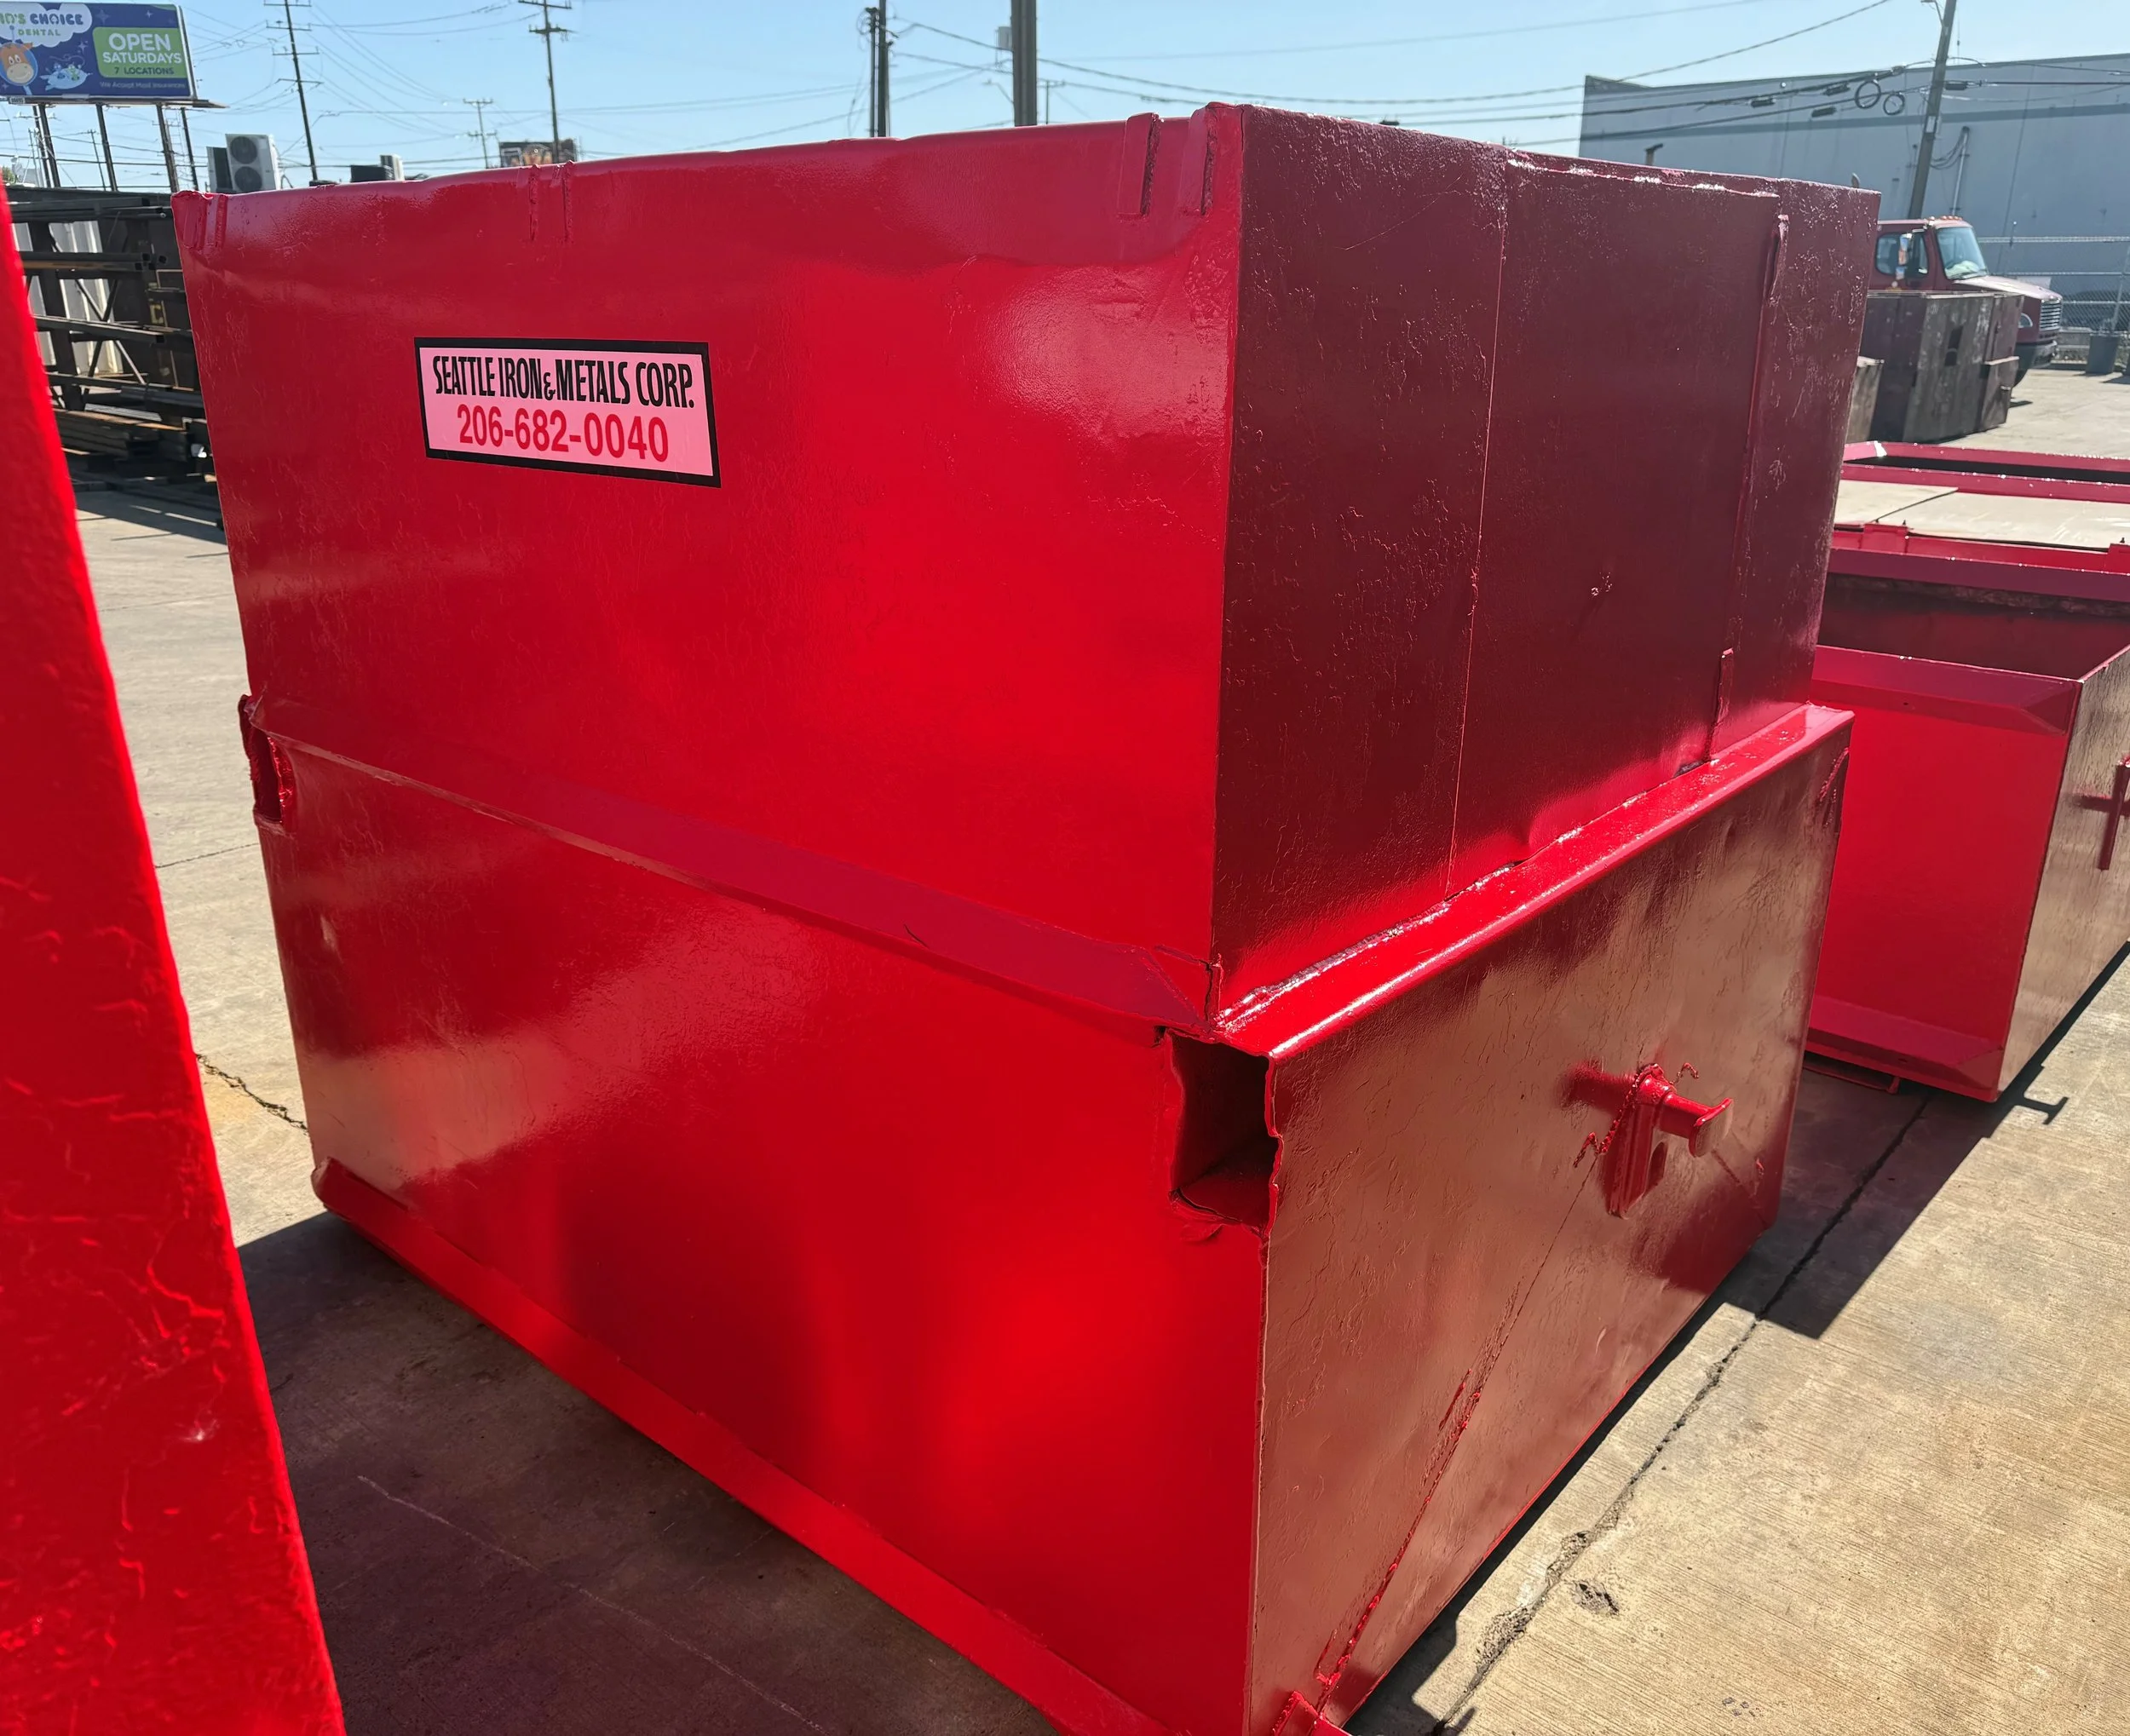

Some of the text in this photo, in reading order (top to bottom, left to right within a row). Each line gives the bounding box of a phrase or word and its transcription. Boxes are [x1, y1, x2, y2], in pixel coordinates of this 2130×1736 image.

[30, 13, 83, 26] CHOICE
[18, 28, 61, 37] DENTAL
[108, 32, 171, 51] OPEN
[102, 51, 182, 64] SATURDAYS
[114, 66, 175, 75] 7 LOCATIONS
[432, 355, 496, 397] SEATTLE
[499, 357, 543, 400] IRON
[556, 359, 630, 405] METALS
[636, 361, 695, 409] CORP.
[457, 403, 669, 463] 206-682-0040
